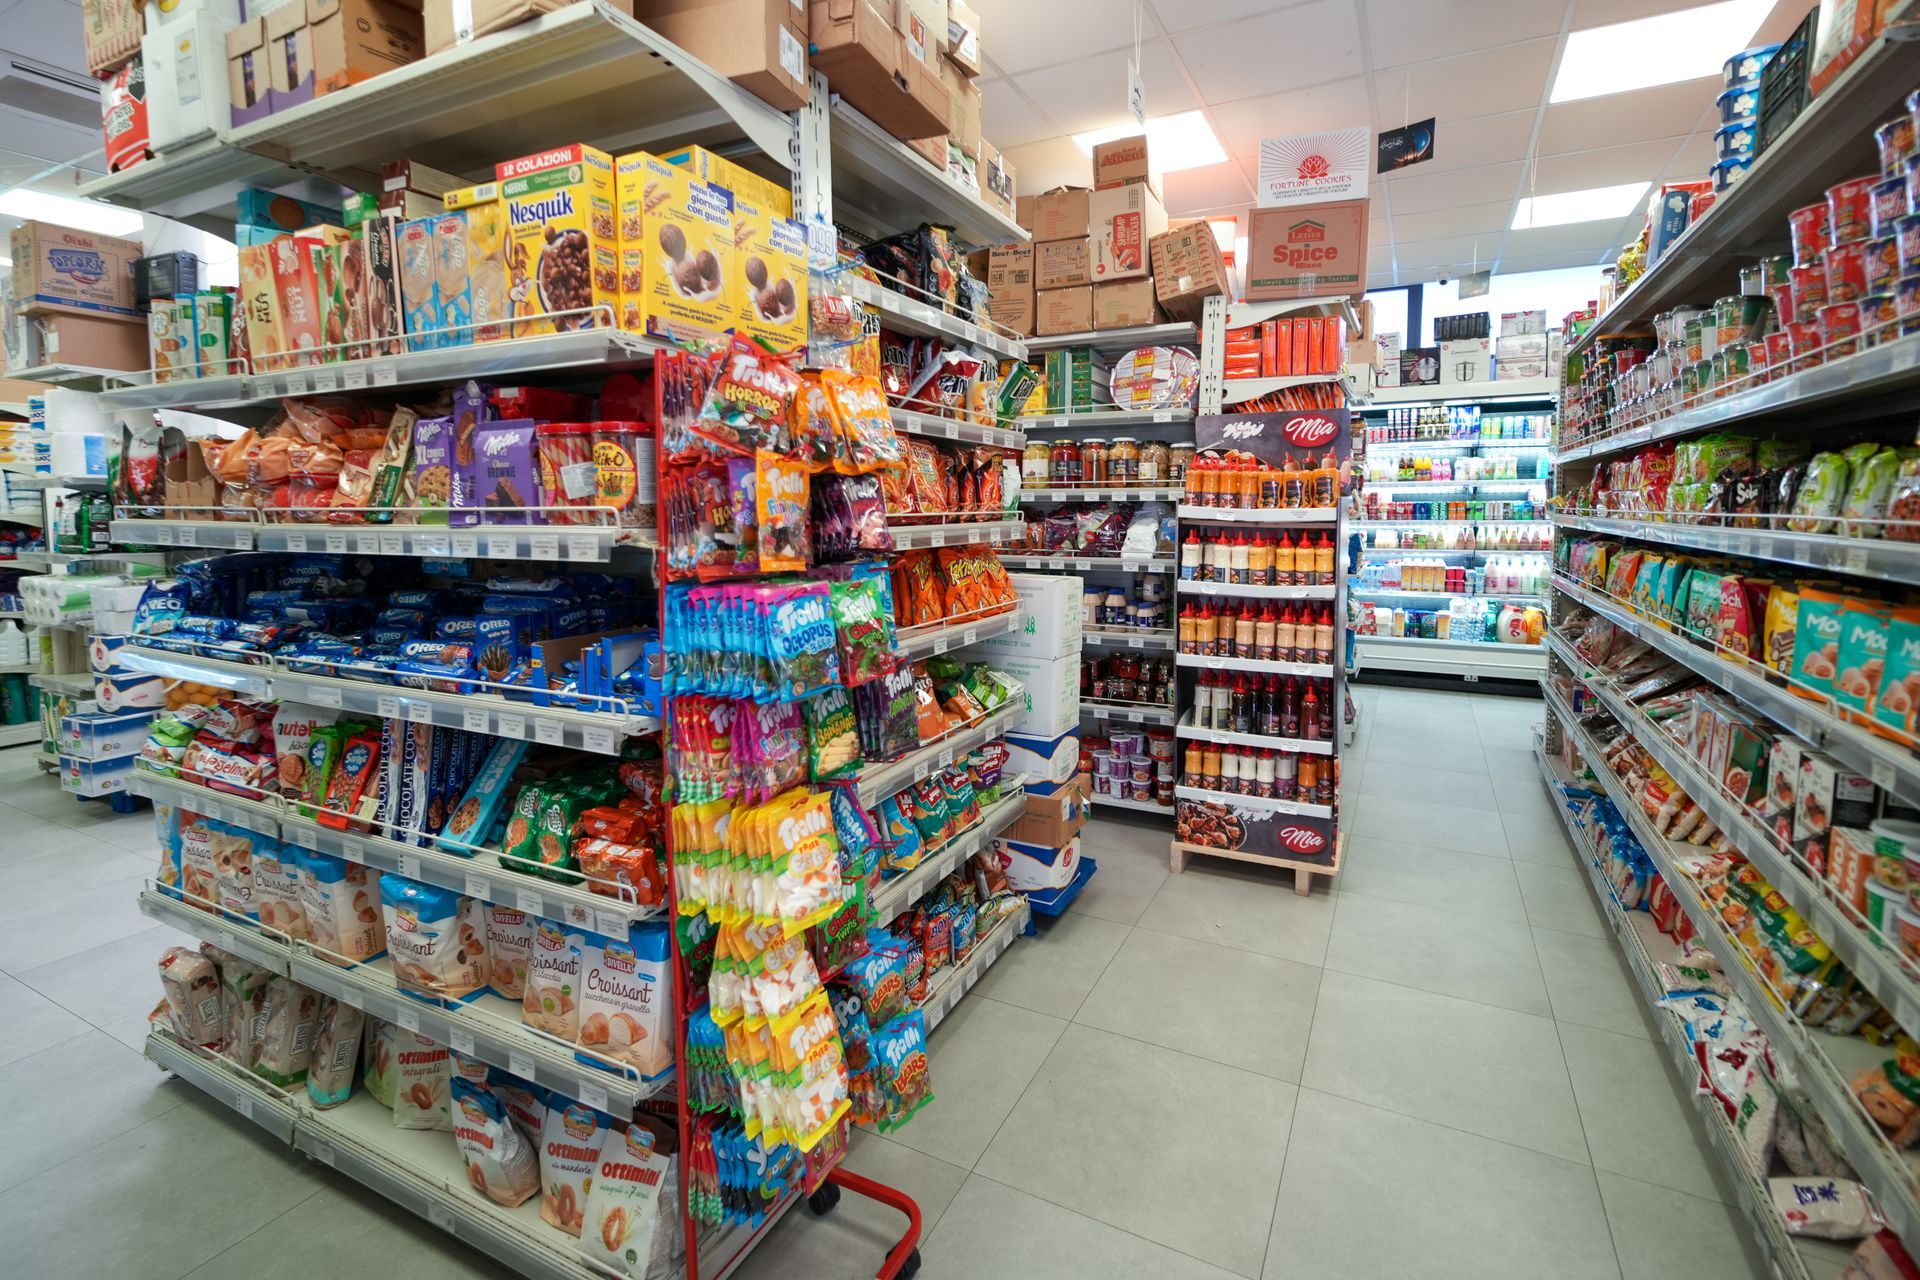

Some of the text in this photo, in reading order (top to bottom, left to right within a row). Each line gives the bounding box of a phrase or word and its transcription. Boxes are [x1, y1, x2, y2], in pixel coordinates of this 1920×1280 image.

[503, 149, 573, 177] 12 COLAZIONI
[584, 153, 612, 171] Nesquik
[646, 159, 674, 178] Nesquik
[1271, 175, 1353, 191] FORTUNE COOKIES
[509, 191, 573, 226] Nesquik
[687, 204, 730, 228] con gusto!
[691, 195, 726, 215] giornata
[1273, 243, 1338, 268] Spice
[1296, 262, 1322, 270] Mixes
[262, 291, 272, 323] NUT
[294, 286, 307, 323] NUT
[725, 383, 782, 416] HORROR
[417, 422, 441, 443] Milka
[1285, 416, 1337, 442] Mia
[415, 445, 428, 465] XL
[483, 431, 520, 457] Milka
[452, 471, 464, 509] Milka
[479, 619, 511, 632] OREO
[559, 609, 588, 626] OREO
[777, 600, 825, 635] Trolli
[406, 643, 446, 656] OREO
[885, 668, 913, 698] Trolli
[377, 717, 393, 831] CHOCOLATE COOK
[401, 721, 416, 837] CHOCOLATE COOK
[779, 811, 827, 850] Trolli
[1280, 826, 1325, 849] Mia
[255, 867, 298, 895] Croissant
[827, 903, 860, 938] Cherry
[835, 919, 858, 943] Twins
[603, 957, 636, 975] DIVELLA
[865, 949, 899, 989] Trolli
[587, 968, 654, 1005] Croissant
[790, 1015, 836, 1061] Trolli
[886, 1025, 921, 1069] Trolli
[402, 1064, 442, 1082] integrali
[628, 1186, 636, 1197] 7
